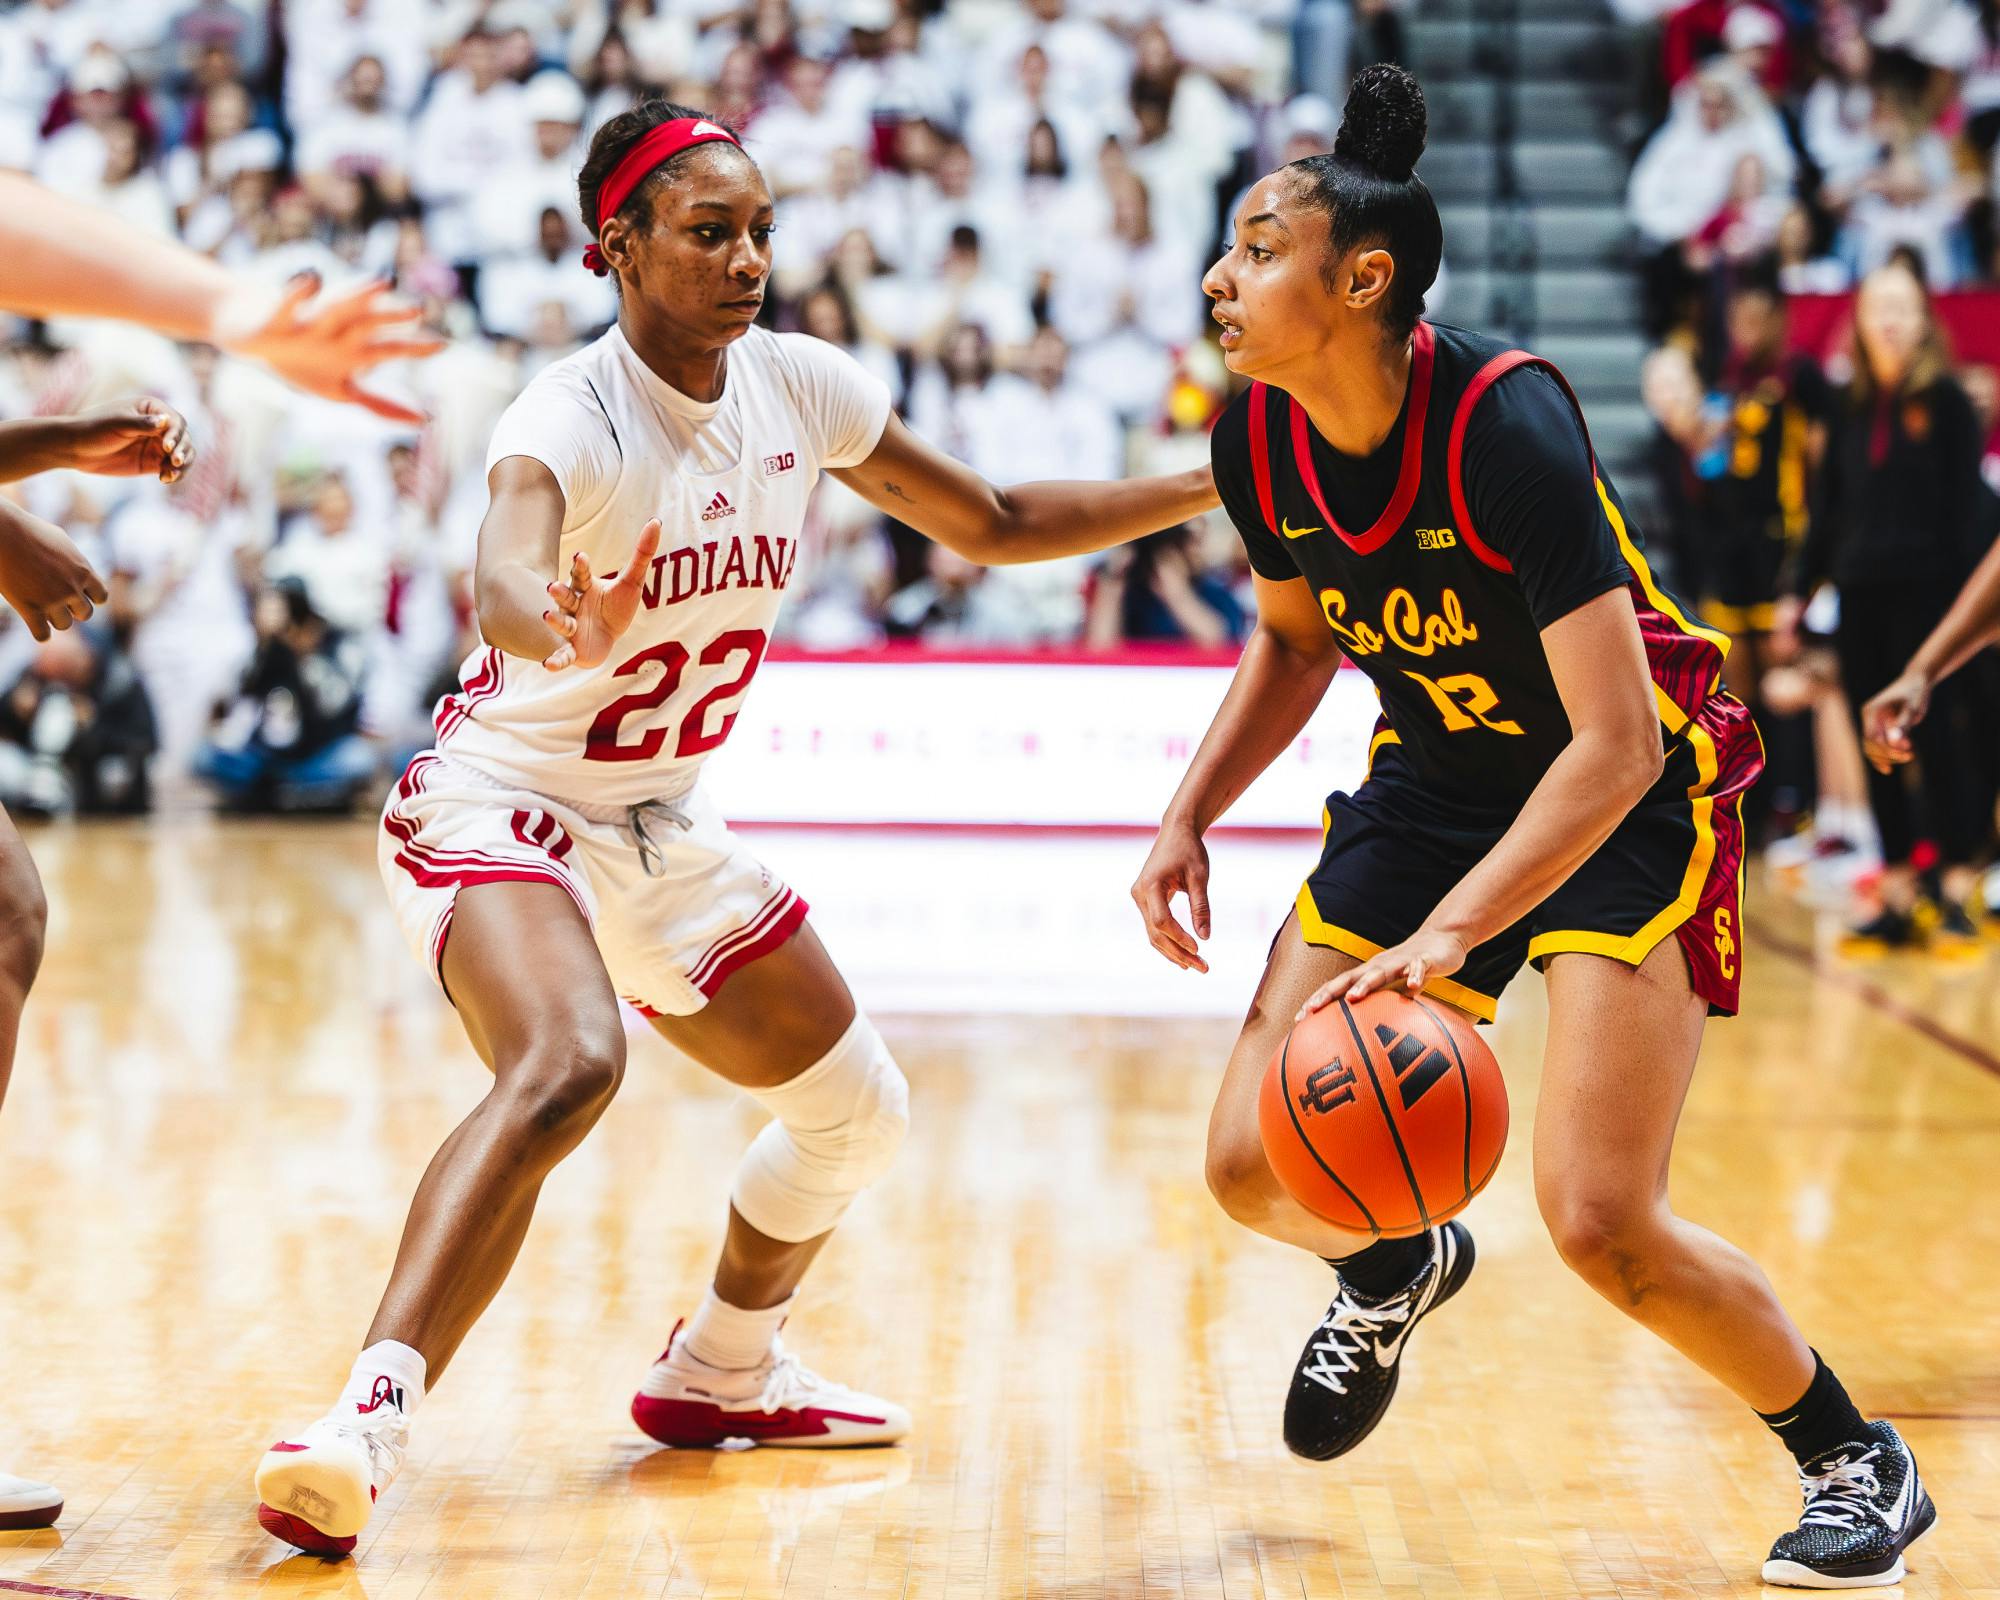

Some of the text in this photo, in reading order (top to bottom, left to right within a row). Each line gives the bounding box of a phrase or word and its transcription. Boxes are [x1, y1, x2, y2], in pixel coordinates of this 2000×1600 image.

[701, 506, 737, 522] adidas
[600, 535, 797, 611] NDIANA
[1319, 587, 1479, 657] So Cal
[582, 628, 767, 762] 22
[1399, 670, 1526, 735] 12
